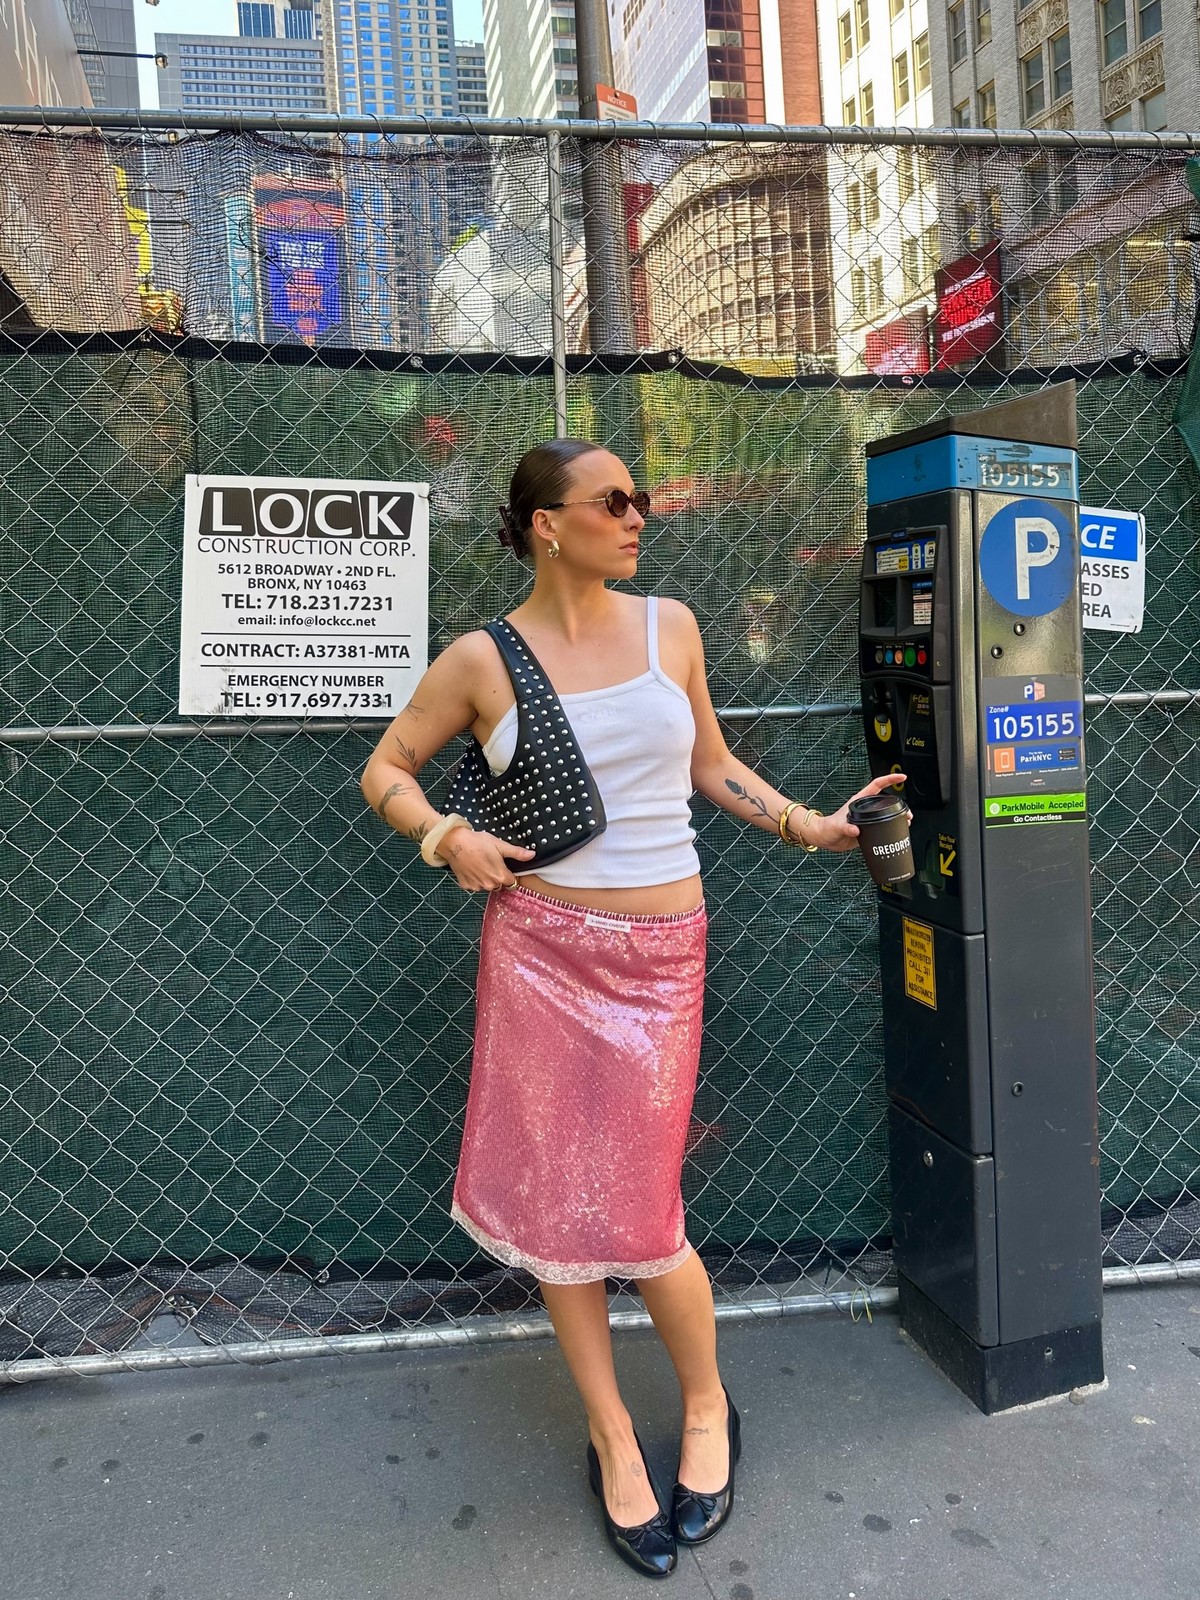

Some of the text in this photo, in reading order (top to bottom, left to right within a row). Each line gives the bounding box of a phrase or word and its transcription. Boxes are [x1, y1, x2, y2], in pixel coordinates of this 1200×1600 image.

[607, 95, 627, 108] NOTICE
[211, 491, 405, 536] LOCK
[197, 537, 416, 557] CONSTRUCTION CORP.
[1015, 517, 1060, 600] P
[218, 563, 396, 578] 5612 BROADWAY 2ND FL.
[247, 578, 367, 591] BRONX, NY 10463
[222, 593, 393, 611] TEL: 718.231.7231
[237, 615, 376, 627] email: info@lockcc.net
[201, 643, 410, 659] CONTRACT: A37381-MTA
[227, 674, 385, 687] EMERGENCY NUMBER
[221, 692, 393, 708] TEL: 917.697.7331
[994, 713, 1075, 739] 105155
[1020, 753, 1052, 763] ParkNYC
[1002, 800, 1084, 812] ParkMobile Accepted
[1024, 814, 1062, 822] Contactless
[872, 836, 911, 856] GREGORYS
[909, 960, 922, 973] CALL
